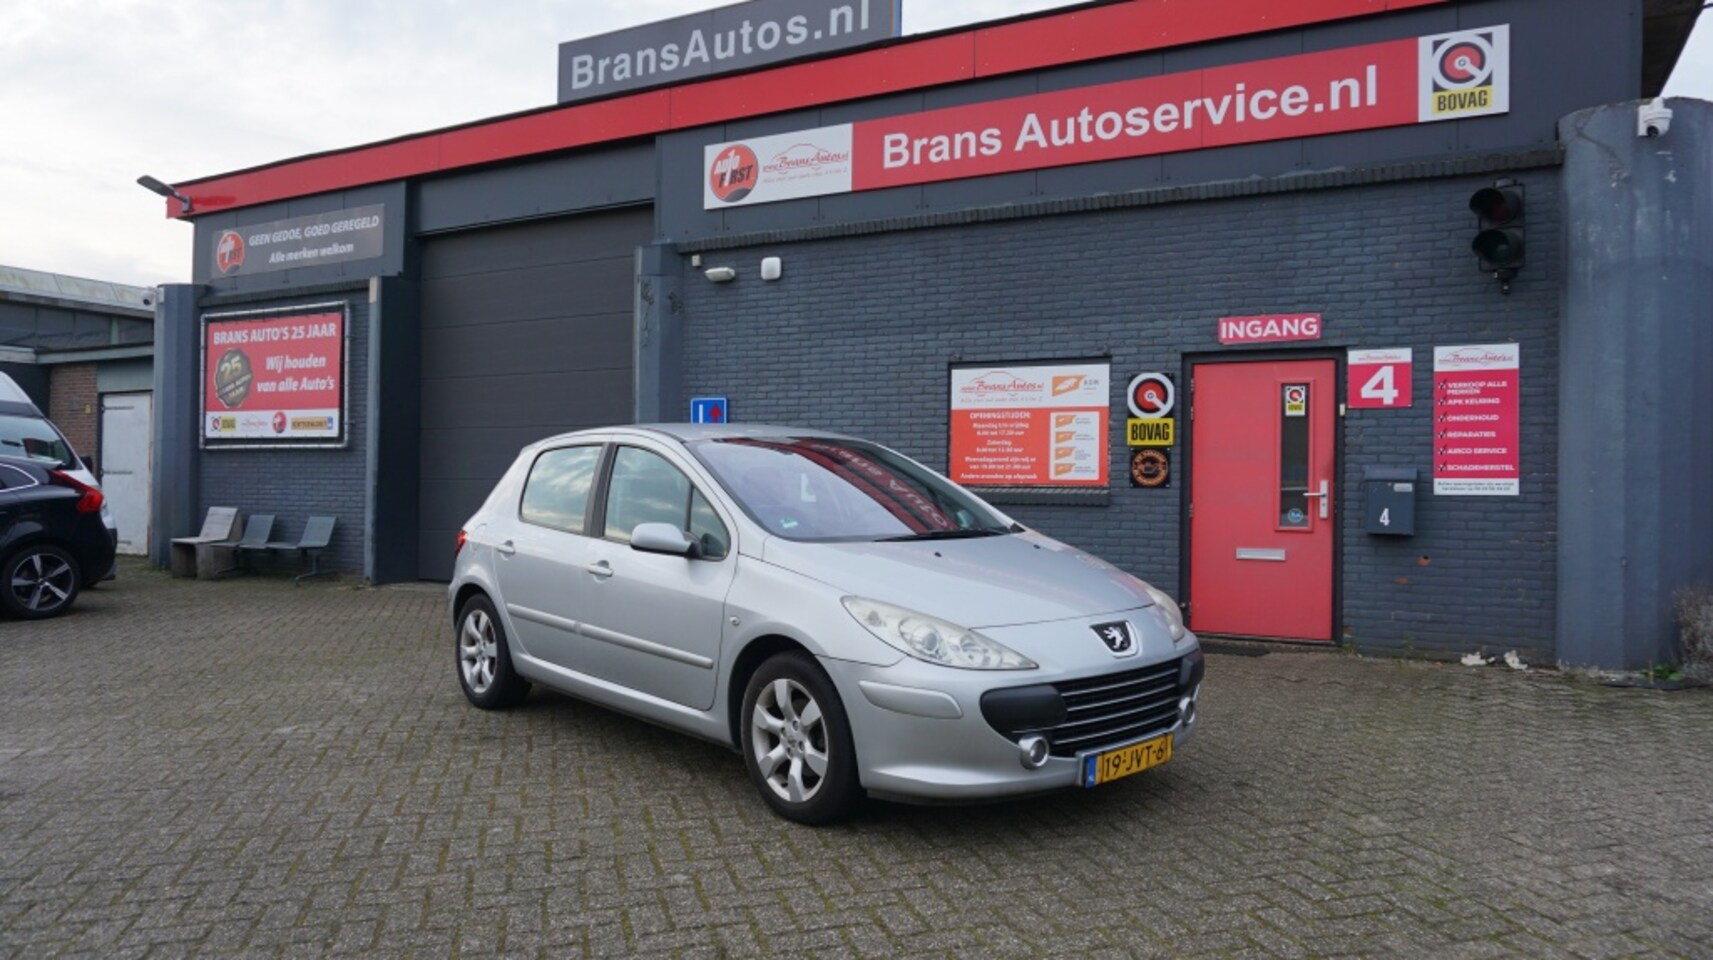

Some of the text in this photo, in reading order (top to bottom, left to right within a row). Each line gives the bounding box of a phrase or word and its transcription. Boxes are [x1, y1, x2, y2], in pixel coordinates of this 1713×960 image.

[571, 0, 870, 89] BransAutos.nl
[1437, 90, 1488, 111] BOVAG
[882, 65, 1378, 169] Brans Autoservice.nl
[249, 215, 380, 247] GEEN GEDOE, GOED GEREGELD
[269, 251, 286, 264] Alle
[286, 247, 319, 261] merken
[213, 322, 337, 345] BRANS AUTO'S 25 JAAR
[1221, 318, 1318, 338] INGANG
[266, 353, 327, 373] Wij houden
[257, 381, 276, 392] van
[278, 377, 298, 392] alle
[299, 375, 335, 391] Auto's
[1361, 365, 1399, 405] 4
[1131, 422, 1170, 441] BOVAG
[1379, 508, 1390, 526] 4
